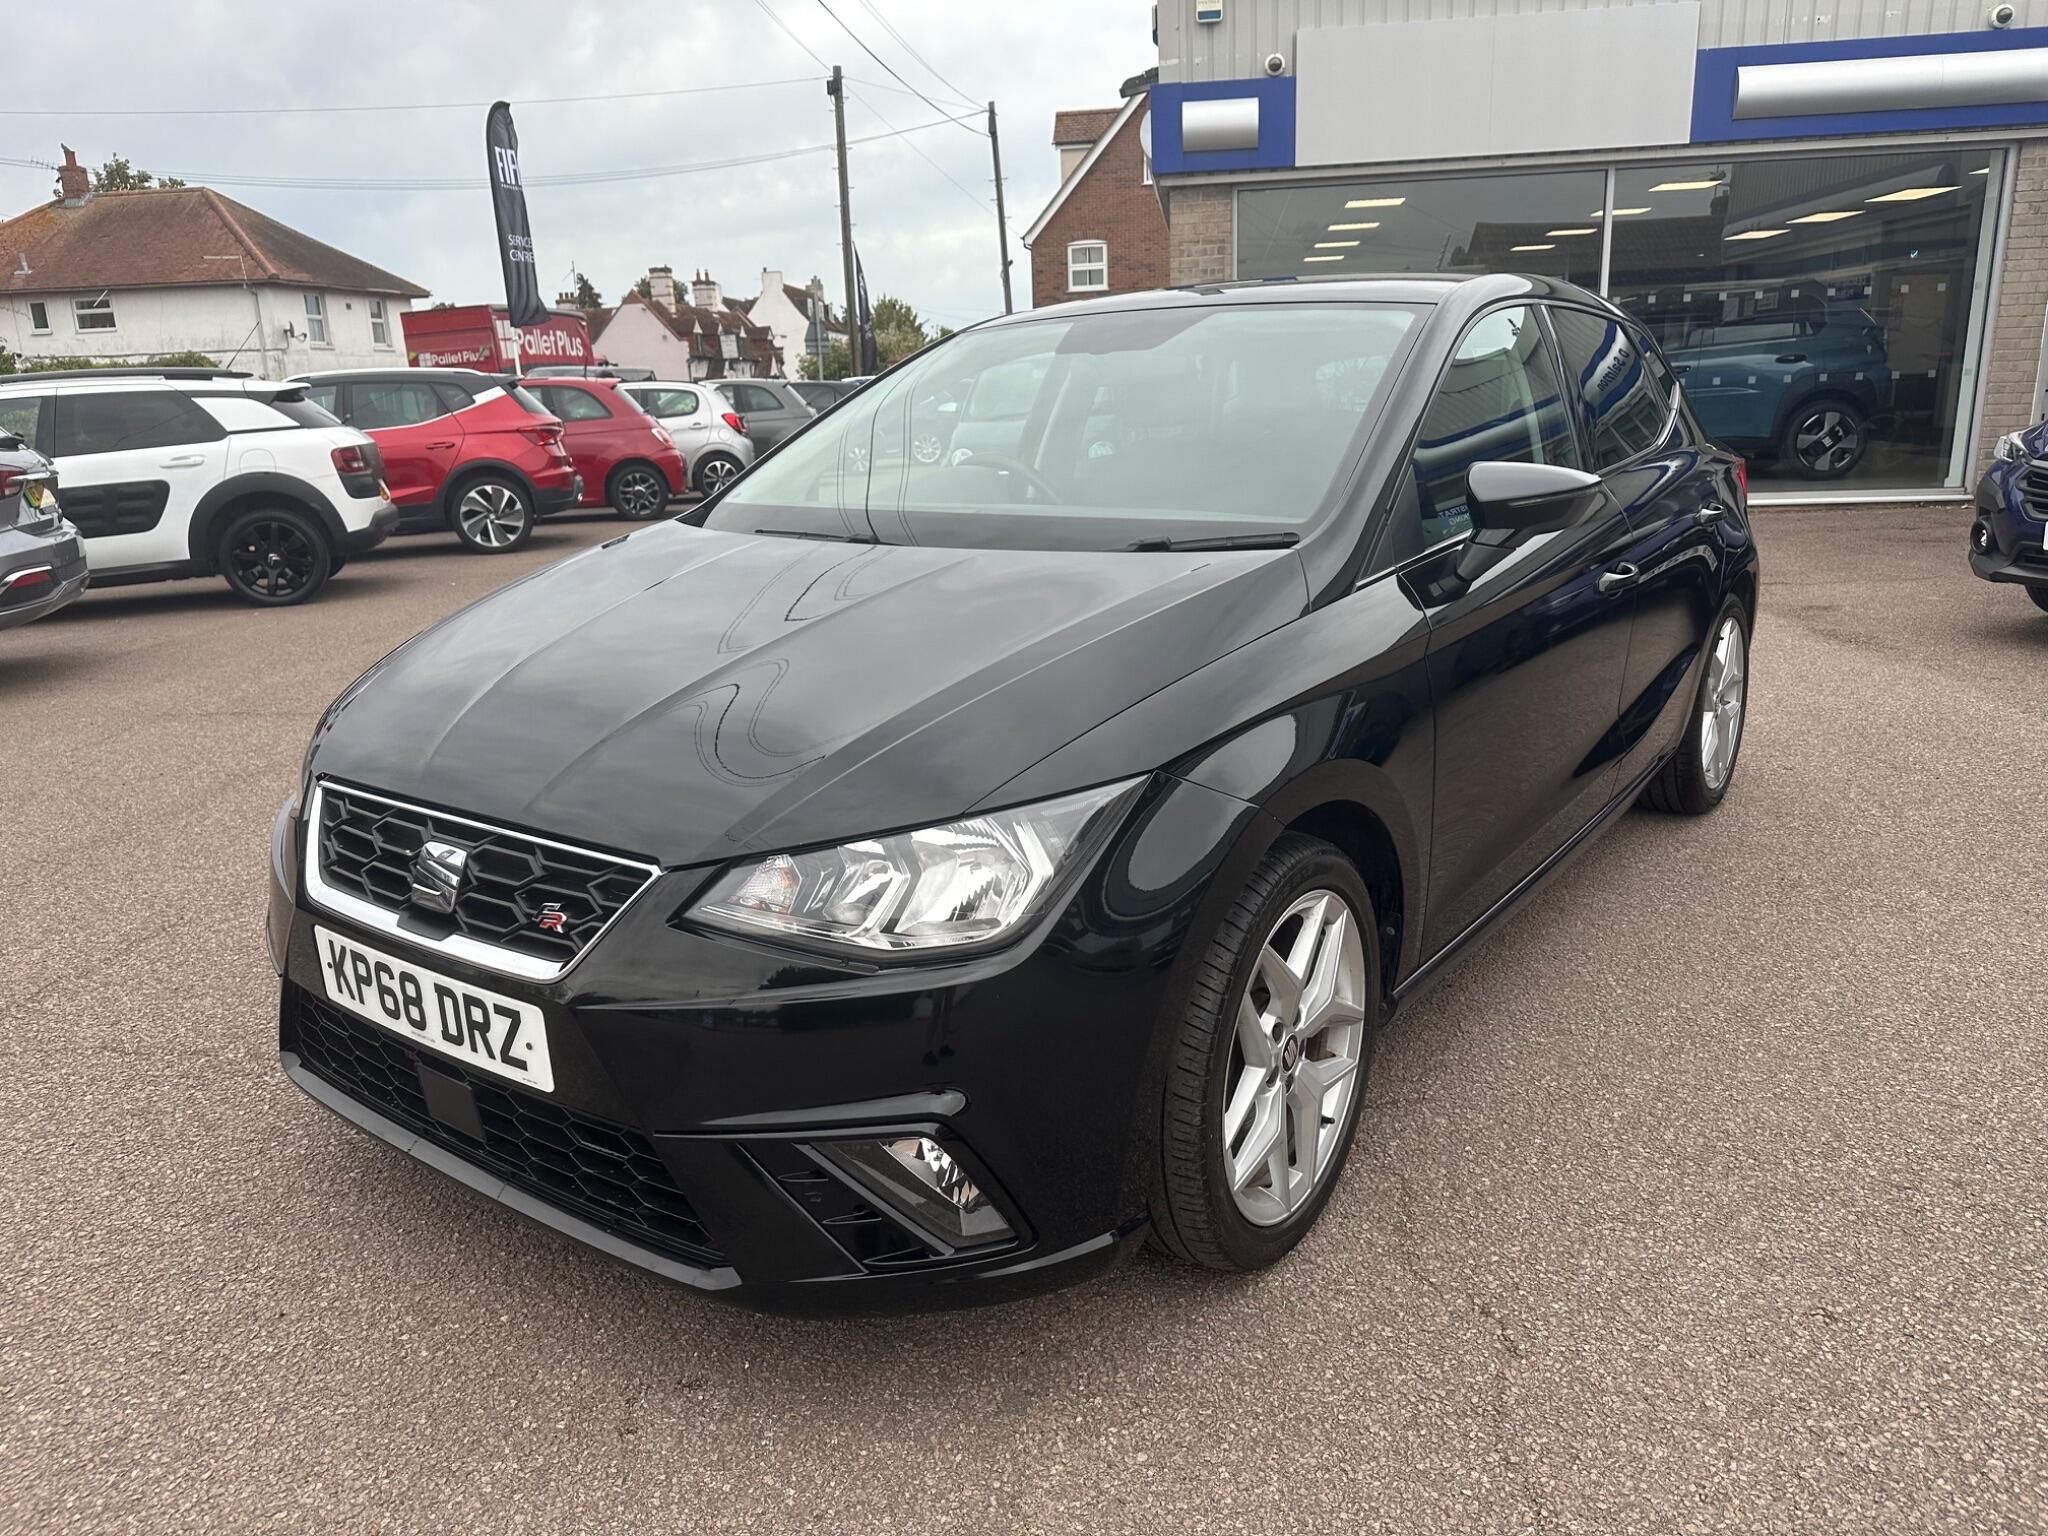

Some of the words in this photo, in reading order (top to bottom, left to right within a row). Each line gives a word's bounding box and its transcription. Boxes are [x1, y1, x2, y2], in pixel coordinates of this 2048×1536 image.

[495, 146, 521, 186] FIA
[431, 351, 462, 365] Pallet
[517, 328, 556, 356] Pallet
[556, 330, 583, 357] Plus
[328, 939, 427, 1031] KP68
[434, 982, 528, 1071] DRZ
